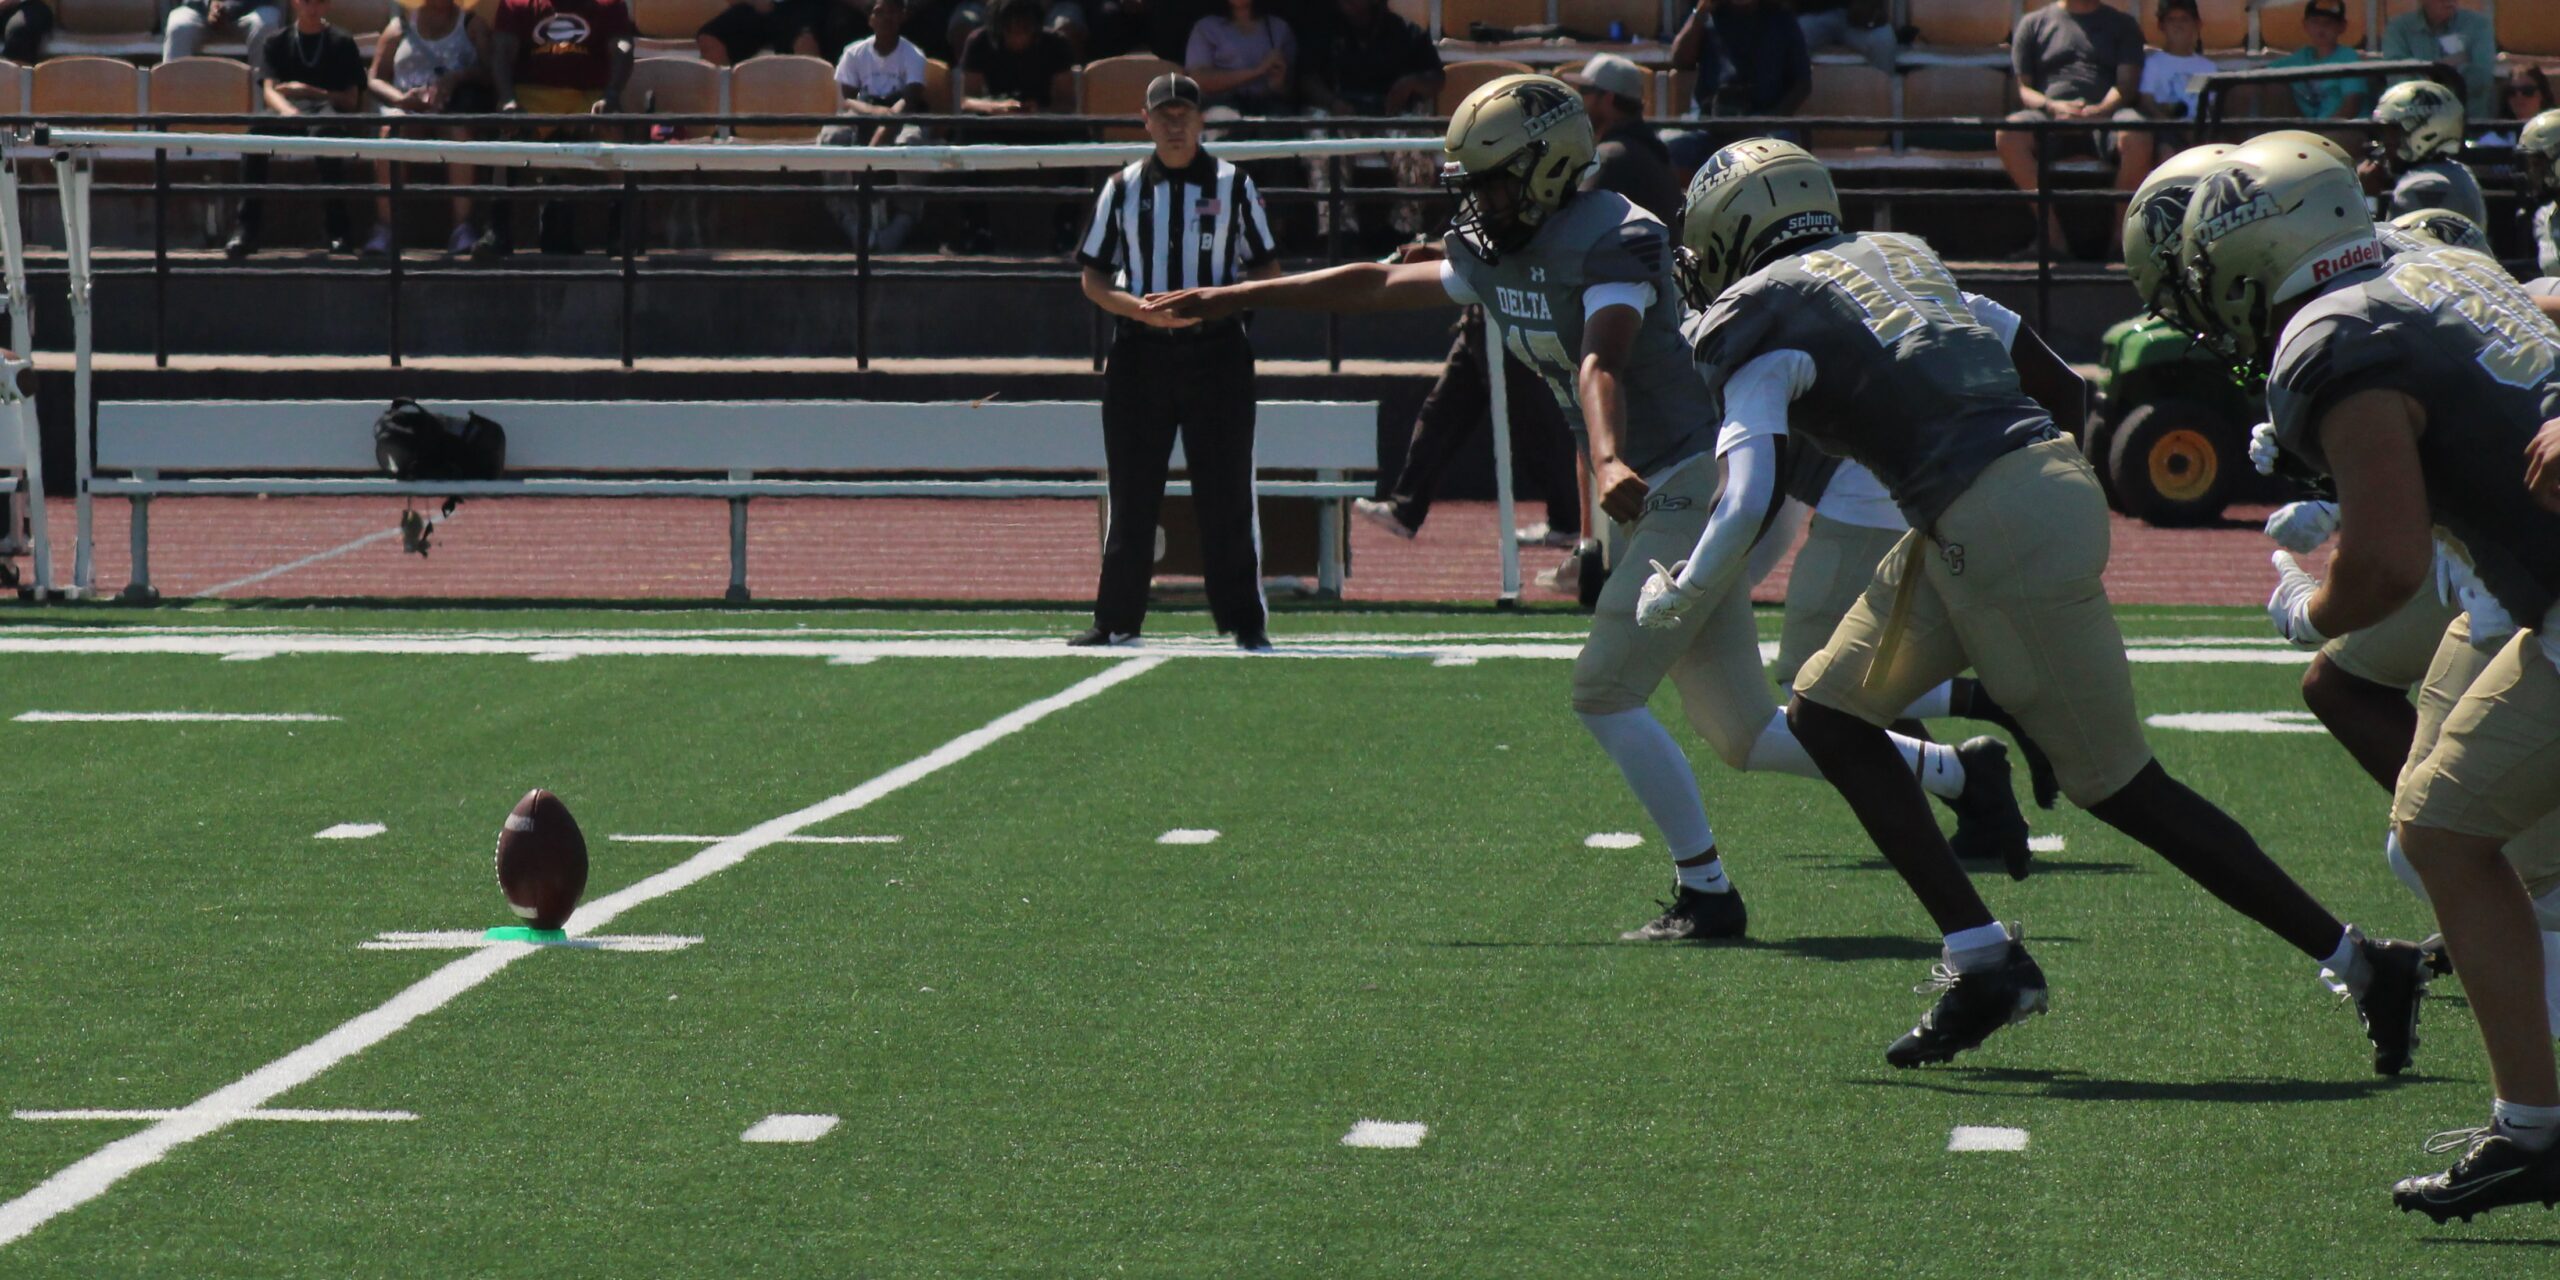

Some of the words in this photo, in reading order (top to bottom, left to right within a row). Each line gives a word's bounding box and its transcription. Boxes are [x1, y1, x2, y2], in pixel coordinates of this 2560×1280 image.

[1523, 97, 1581, 138] DELTA
[2193, 192, 2282, 246] DELTA
[2311, 240, 2380, 283] Riddell
[1496, 286, 1553, 321] DELTA
[1800, 234, 1981, 348] 14
